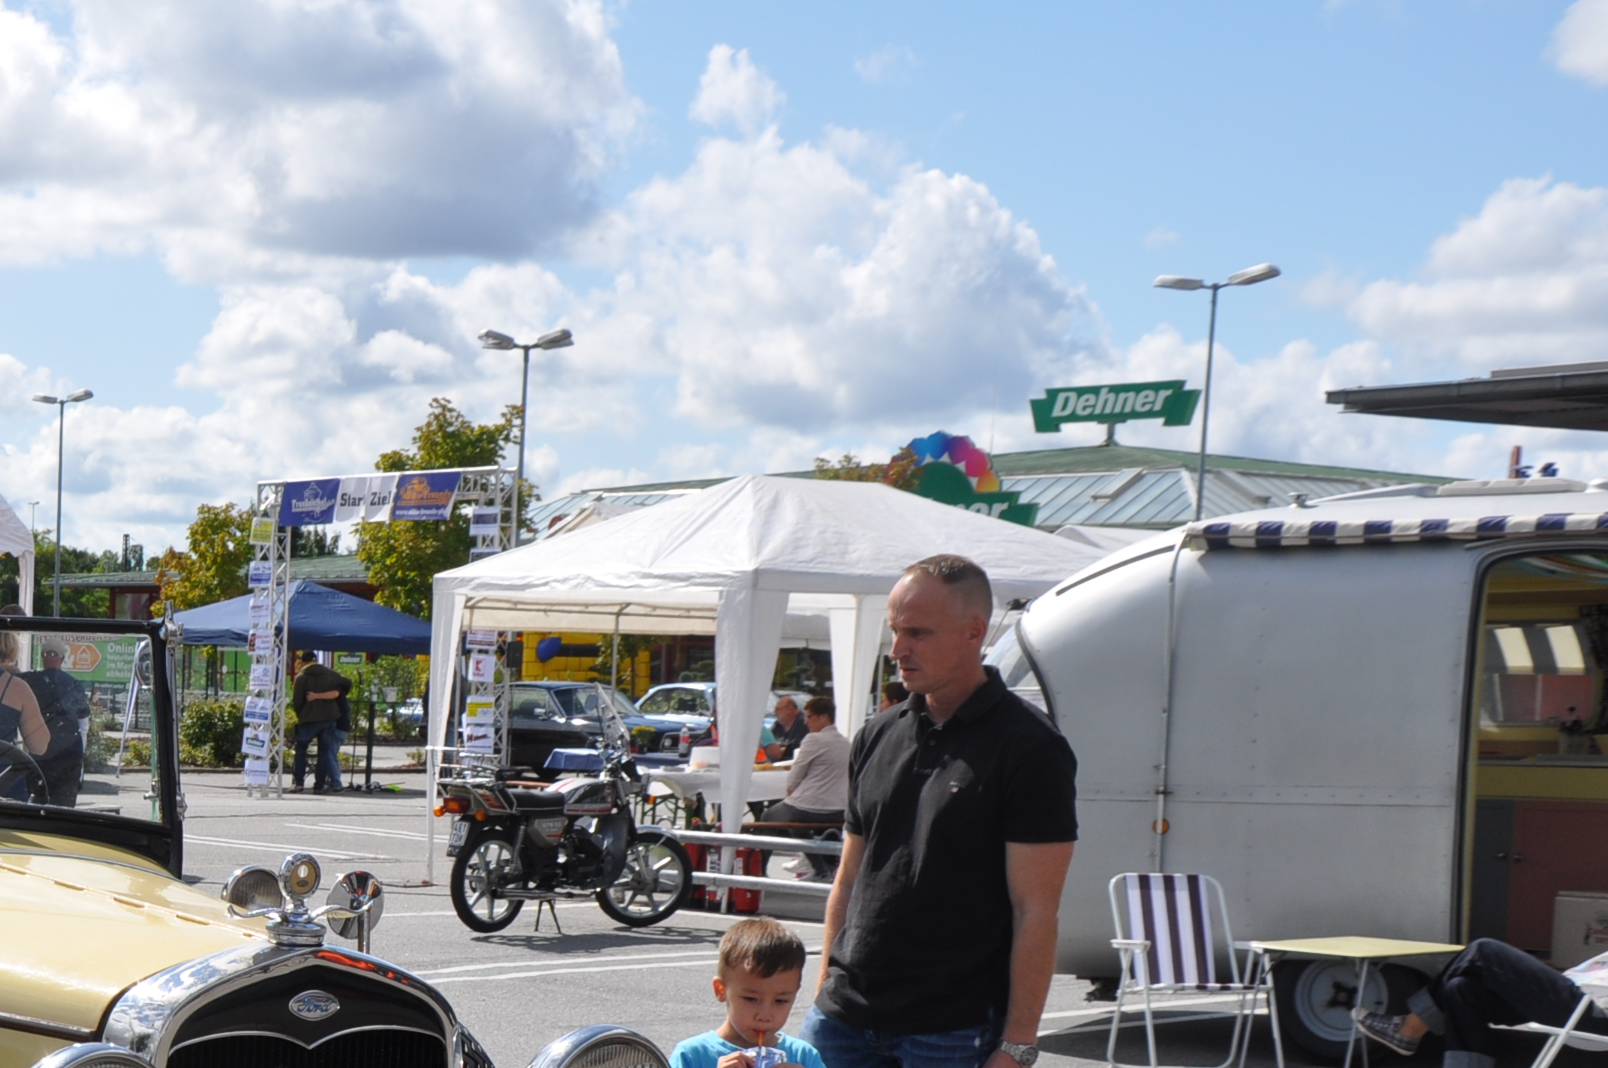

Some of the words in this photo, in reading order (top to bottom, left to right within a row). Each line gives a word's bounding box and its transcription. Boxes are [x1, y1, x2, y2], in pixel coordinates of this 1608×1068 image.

[1051, 387, 1174, 418] Dehner
[370, 490, 392, 506] Ziel
[297, 997, 332, 1013] Ford
